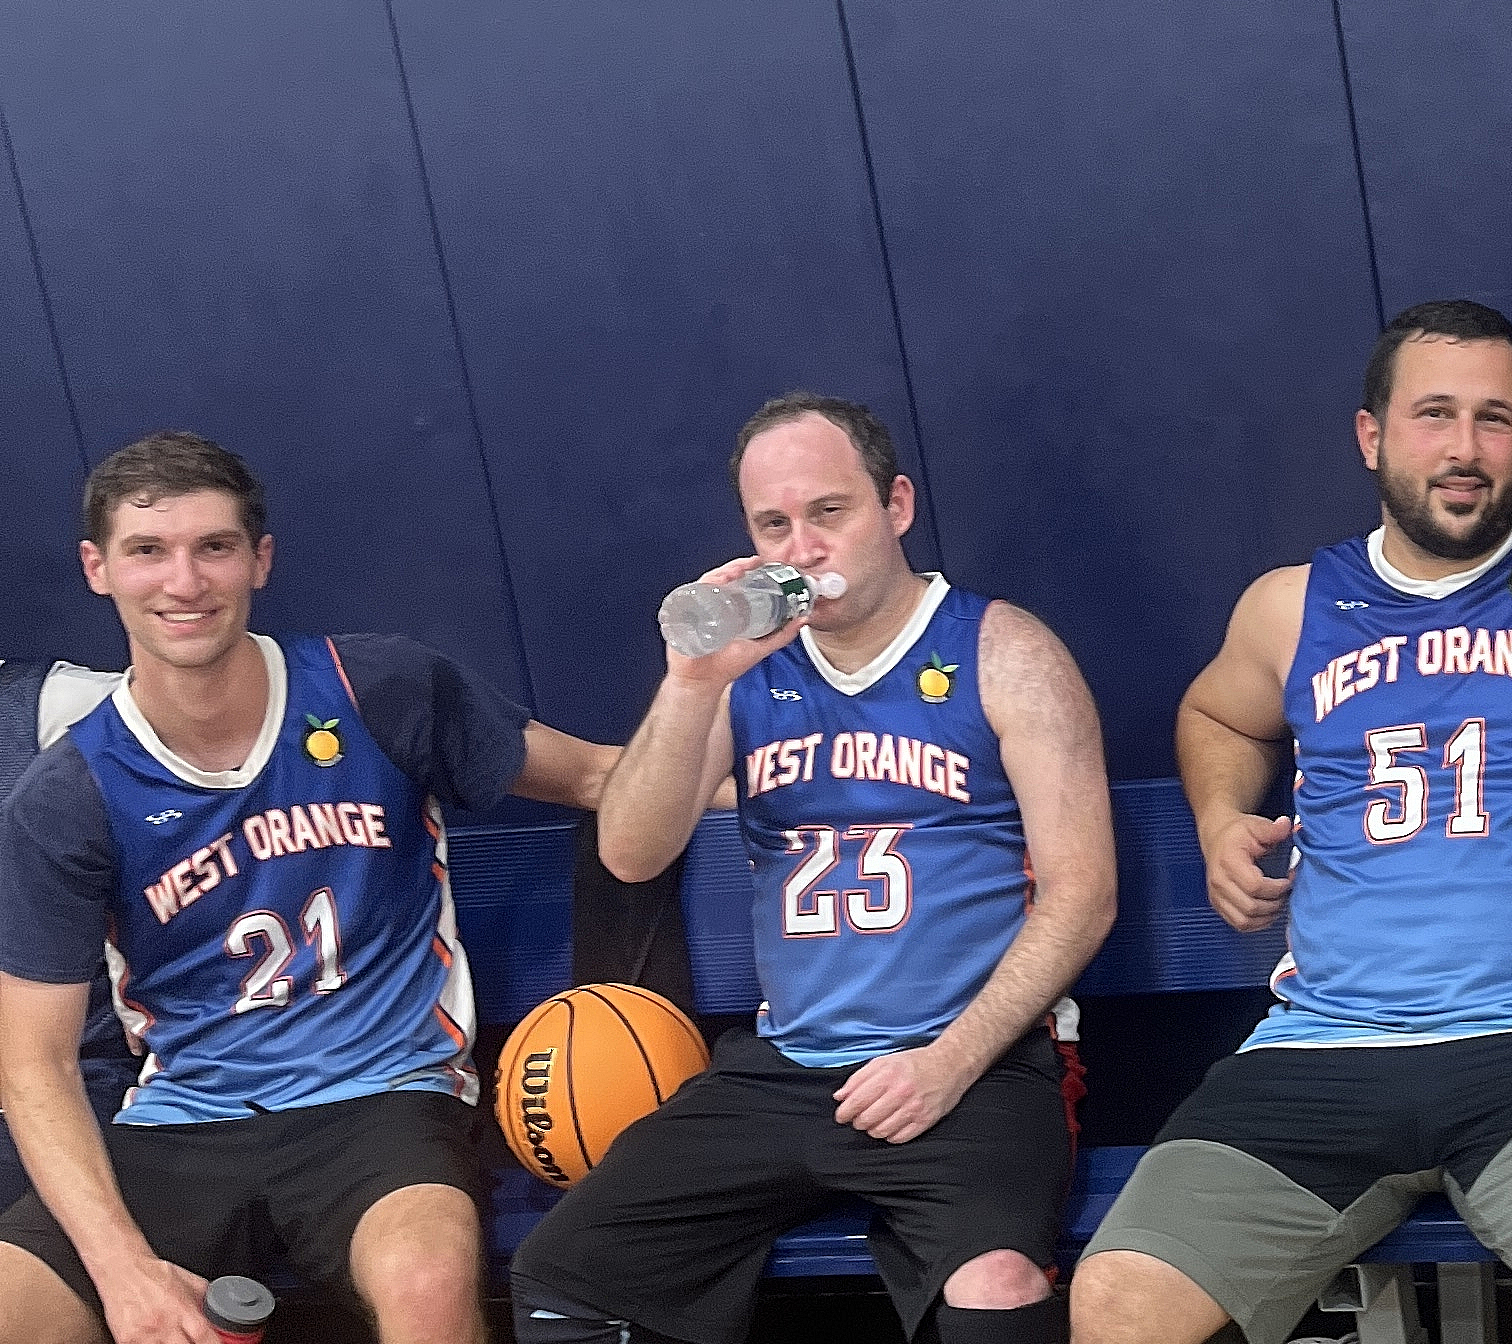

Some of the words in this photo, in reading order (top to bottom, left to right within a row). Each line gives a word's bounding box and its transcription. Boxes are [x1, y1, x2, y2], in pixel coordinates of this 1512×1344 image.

[1311, 635, 1407, 723] WEST
[830, 731, 971, 804] ORANGE
[1363, 717, 1490, 845] 51
[143, 832, 239, 925] WEST
[242, 801, 392, 861] ORANGE
[780, 823, 915, 939] 23
[224, 886, 348, 1015] 21
[521, 1046, 570, 1182] Wilson
